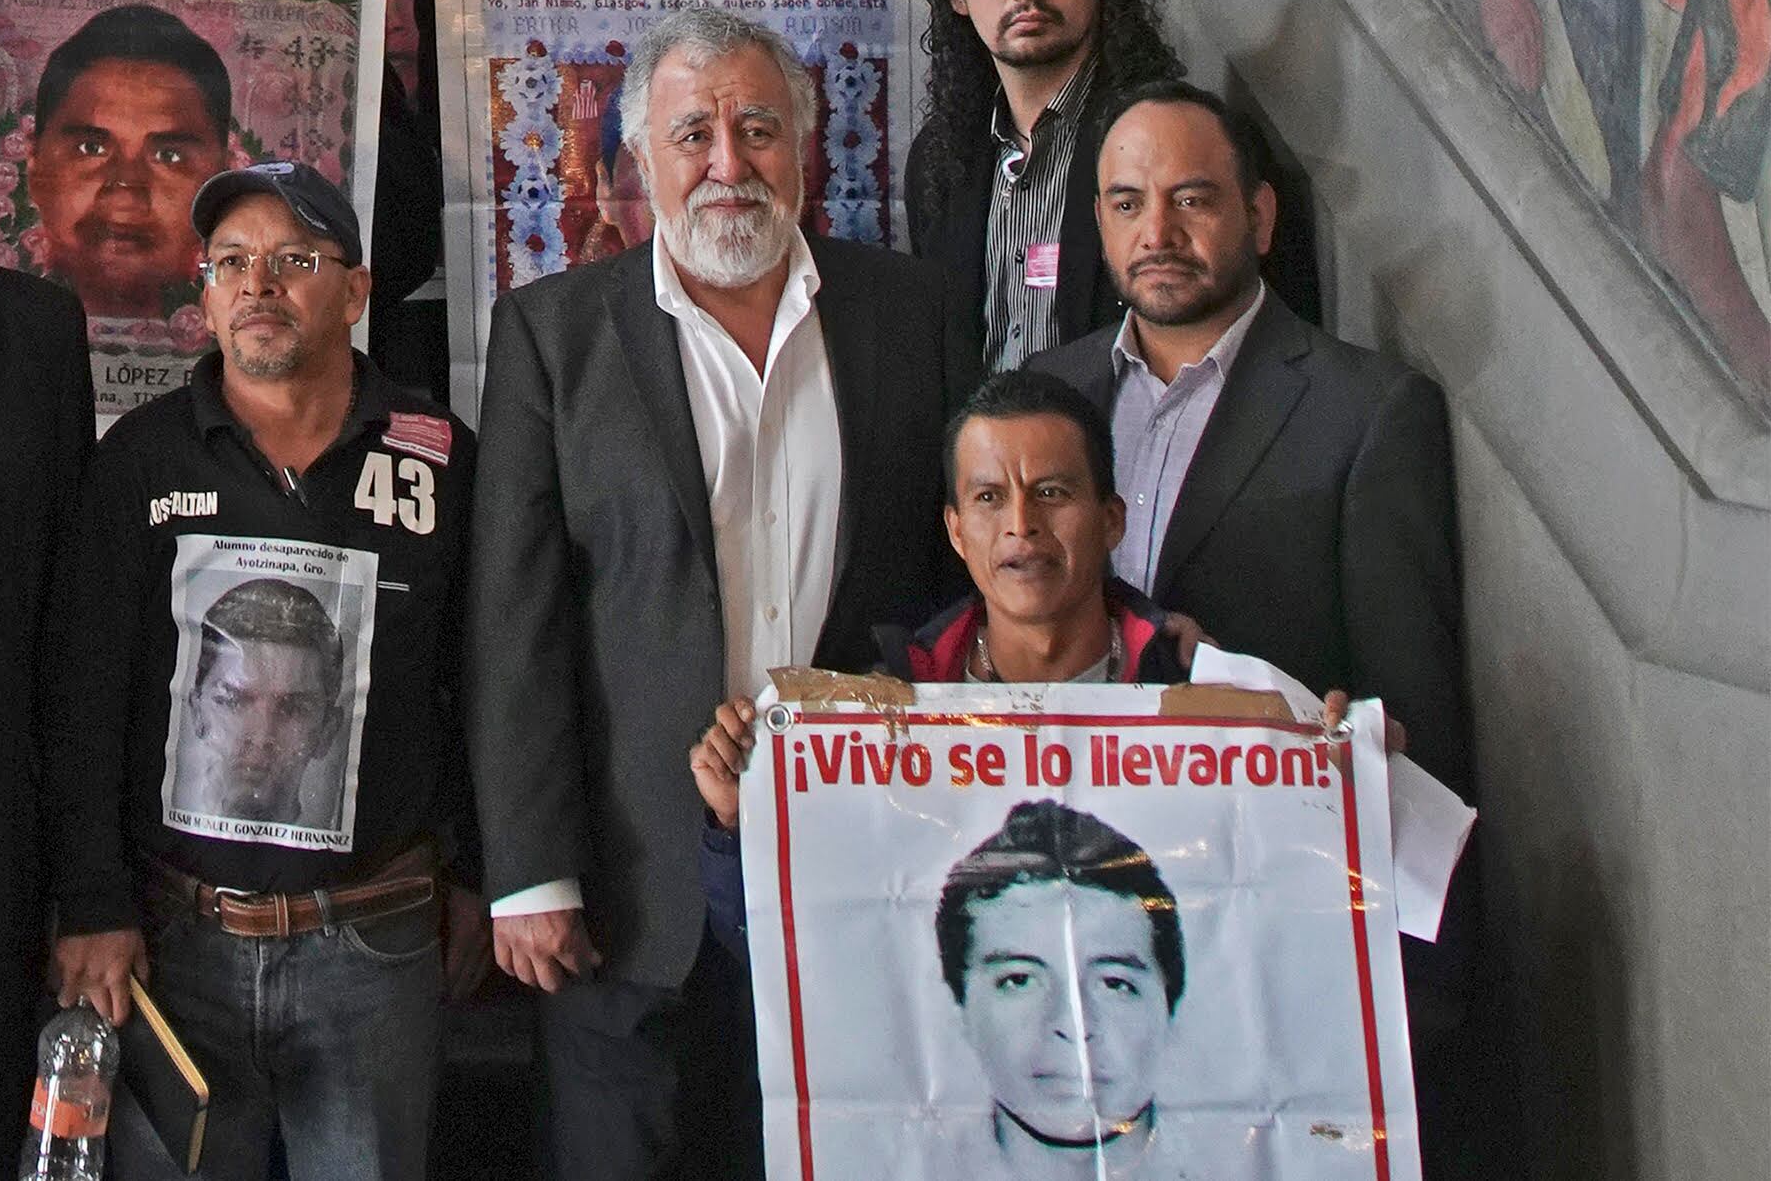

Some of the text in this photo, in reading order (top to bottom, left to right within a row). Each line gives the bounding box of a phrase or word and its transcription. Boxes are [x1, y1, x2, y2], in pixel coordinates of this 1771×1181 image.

[354, 451, 436, 535] 43
[212, 539, 349, 563] Alumno desaparecido de
[235, 556, 327, 576] Ayotzinapa, Gro.
[794, 731, 1331, 794] ¡Vivo se lo llevaron!
[234, 822, 287, 839] GONZÁLEZ
